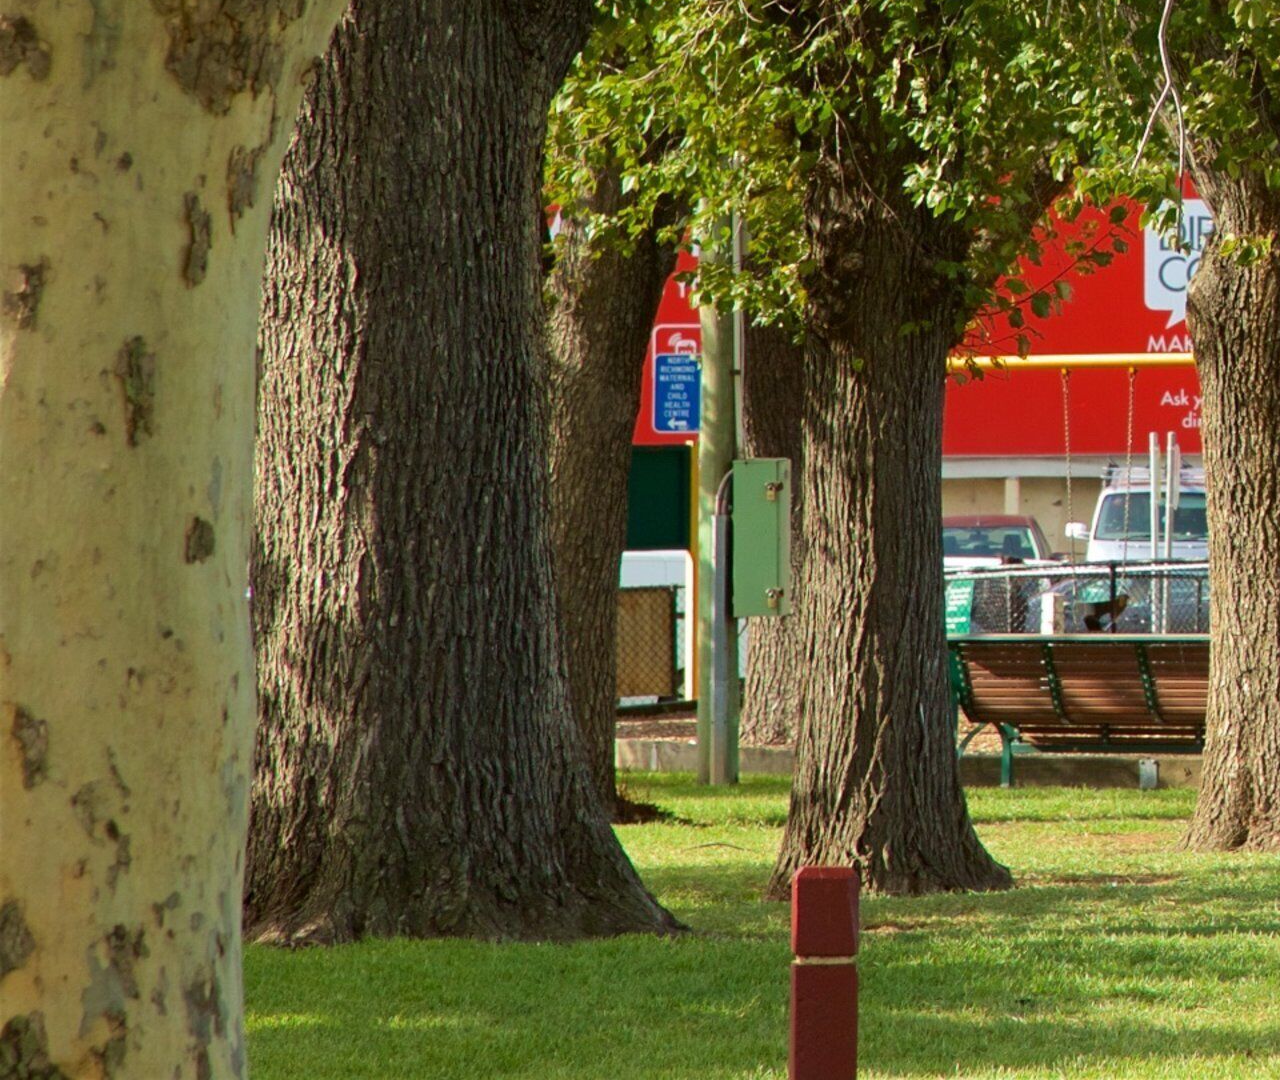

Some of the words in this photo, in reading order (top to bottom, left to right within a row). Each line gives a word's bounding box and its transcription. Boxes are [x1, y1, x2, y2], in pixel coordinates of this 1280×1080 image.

[670, 383, 685, 391] AND
[667, 392, 688, 400] CHILD
[1160, 388, 1189, 406] Ask
[664, 401, 690, 409] HEALTH
[664, 410, 689, 418] CENTRE
